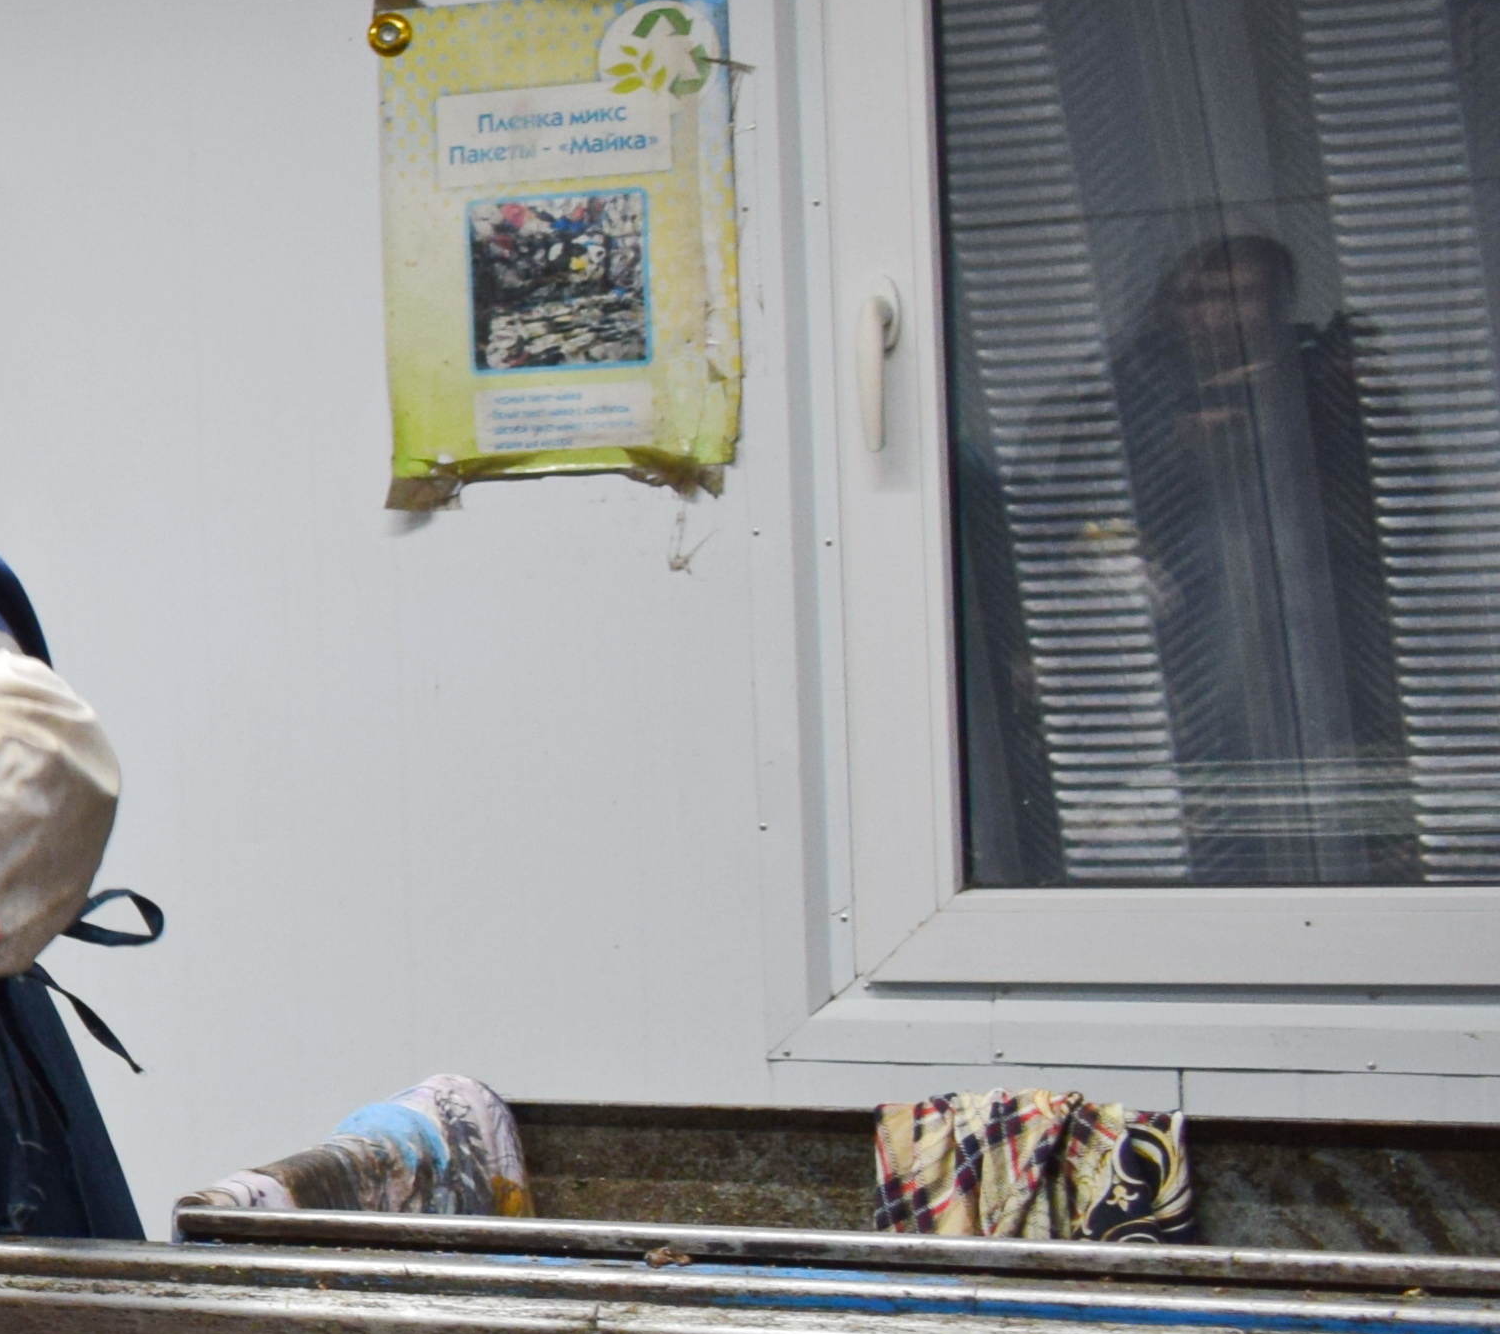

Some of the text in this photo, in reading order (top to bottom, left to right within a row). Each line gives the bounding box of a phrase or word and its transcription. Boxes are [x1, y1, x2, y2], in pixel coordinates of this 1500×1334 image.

[478, 106, 627, 133] Пленка микс
[449, 145, 537, 165] Пакеты
[559, 132, 659, 155] «Майка»
